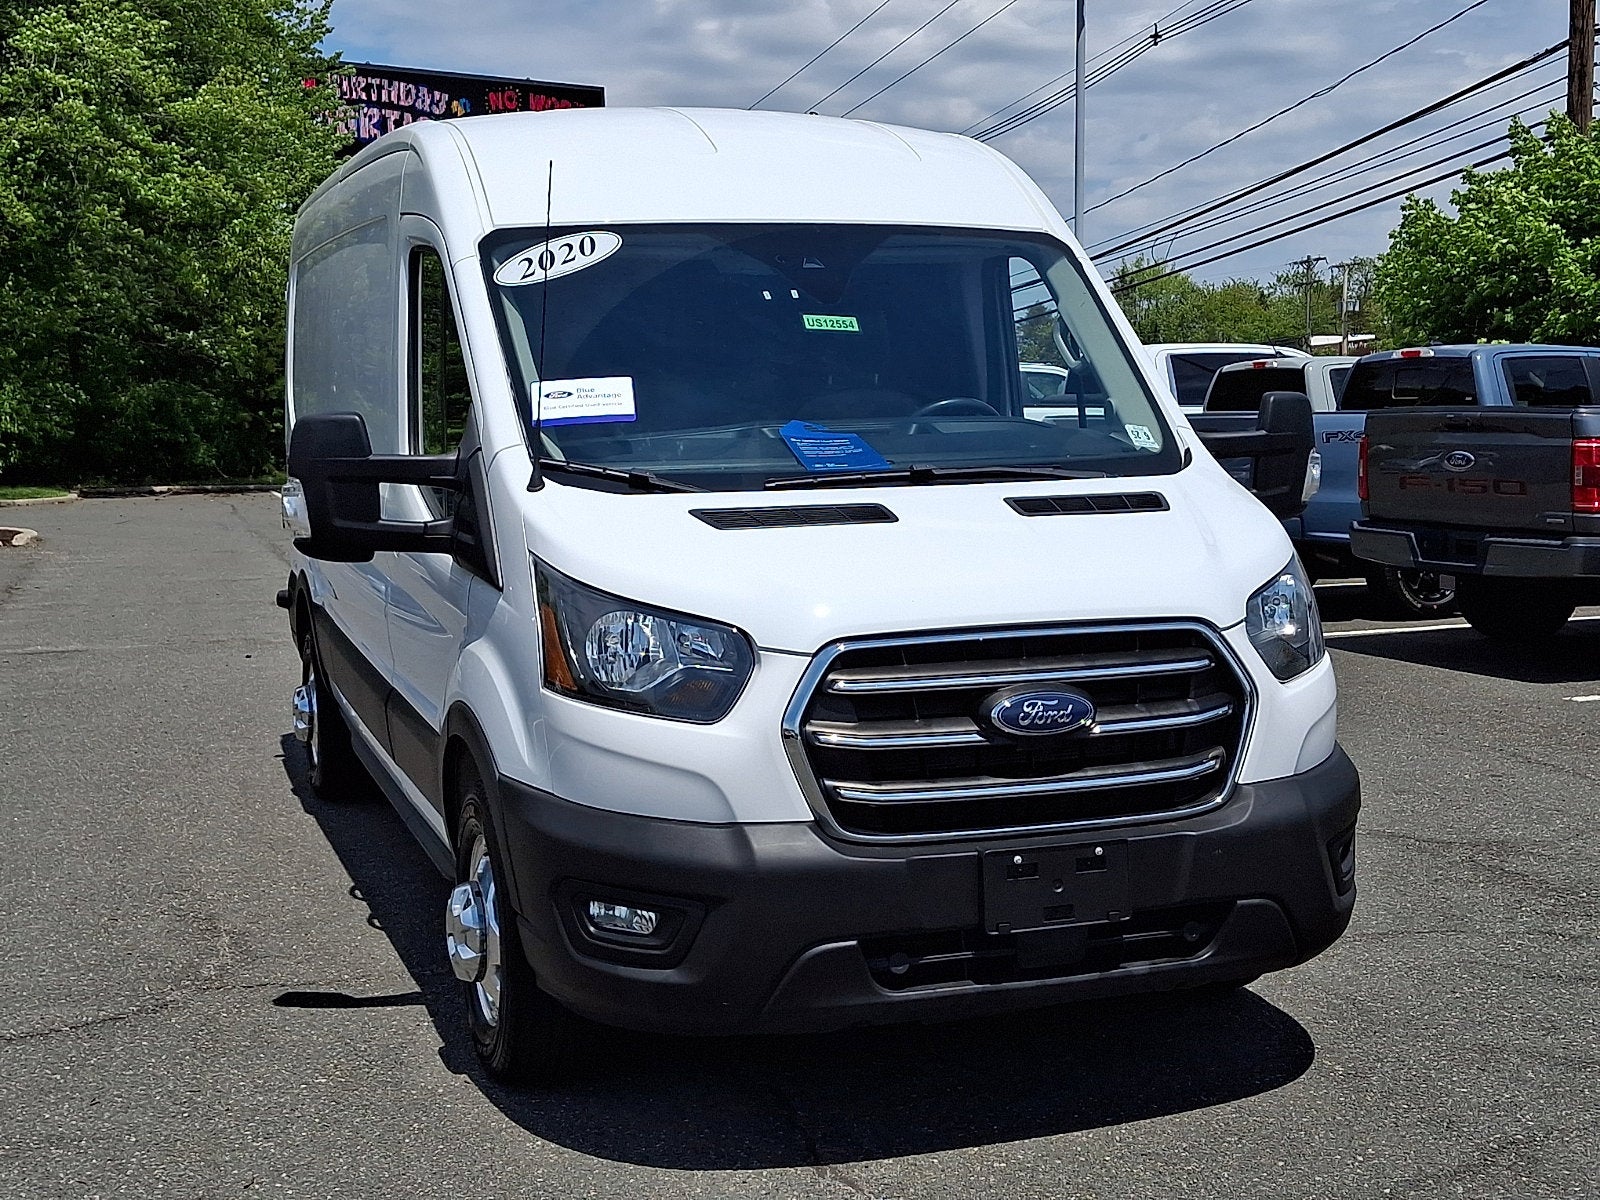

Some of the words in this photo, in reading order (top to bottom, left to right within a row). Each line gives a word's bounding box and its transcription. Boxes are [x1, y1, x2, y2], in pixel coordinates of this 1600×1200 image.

[488, 90, 519, 110] NO
[517, 235, 596, 281] 2020
[806, 317, 855, 329] US12554
[1398, 474, 1528, 496] F-150
[1018, 699, 1074, 726] Ford
